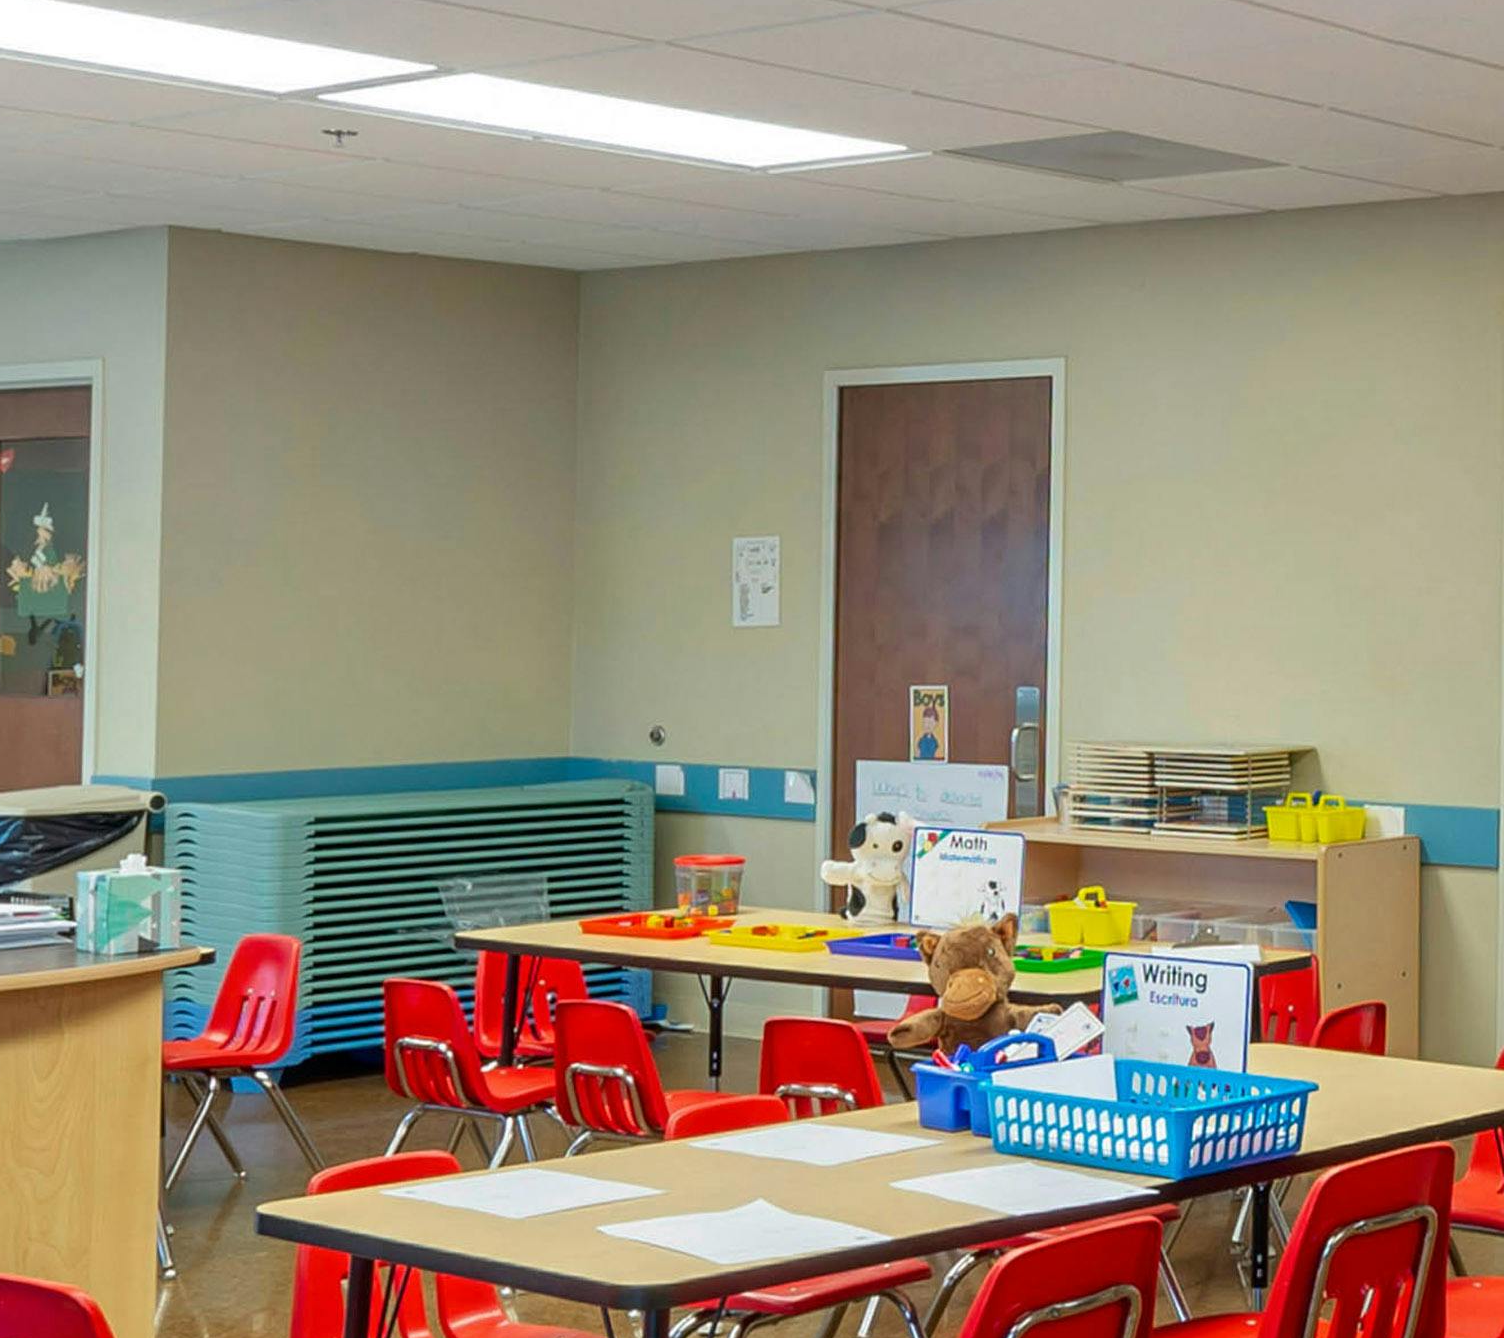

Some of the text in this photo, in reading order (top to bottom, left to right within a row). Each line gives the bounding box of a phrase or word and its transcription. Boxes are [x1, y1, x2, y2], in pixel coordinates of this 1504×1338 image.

[913, 689, 945, 709] Boys
[950, 835, 988, 851] Math
[1142, 963, 1208, 993] Writing
[1149, 991, 1198, 1008] Escritura
